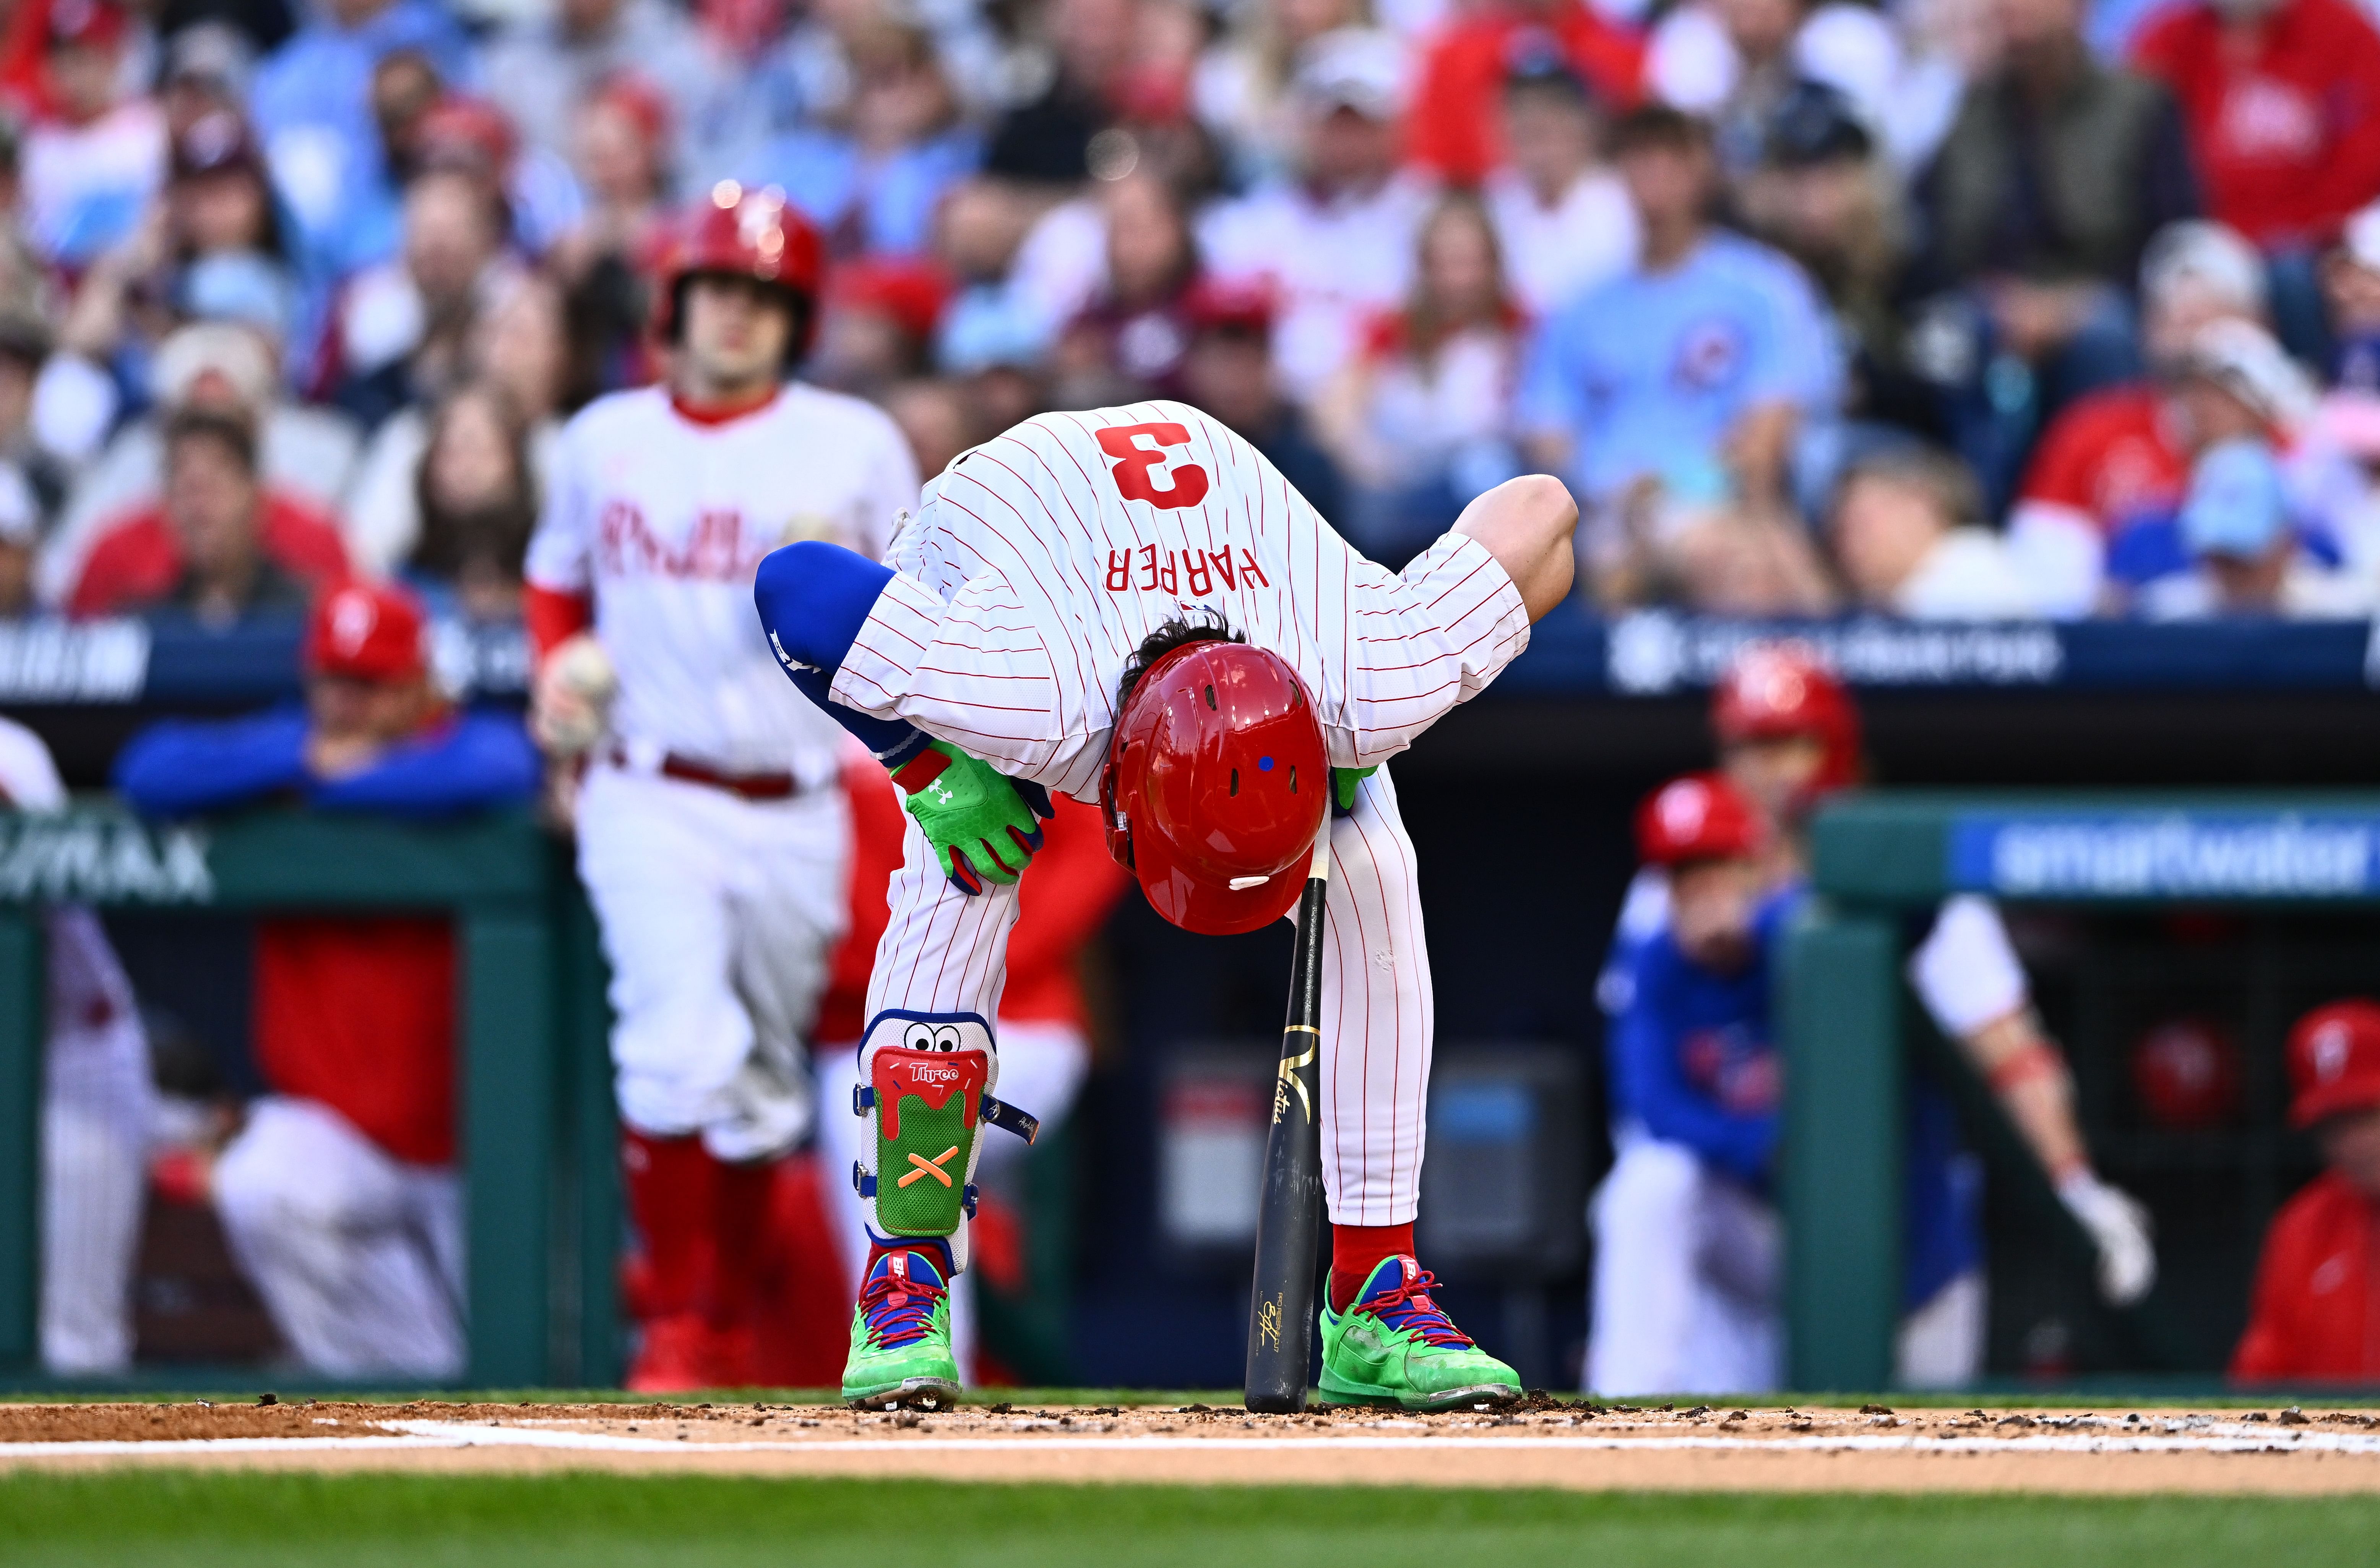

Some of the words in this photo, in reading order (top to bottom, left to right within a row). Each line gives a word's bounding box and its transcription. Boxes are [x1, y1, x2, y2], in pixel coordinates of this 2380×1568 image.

[1095, 422, 1209, 510] 3
[1106, 543, 1270, 597] HARPER
[909, 1062, 959, 1083] Three
[1273, 1033, 1315, 1125] Victus
